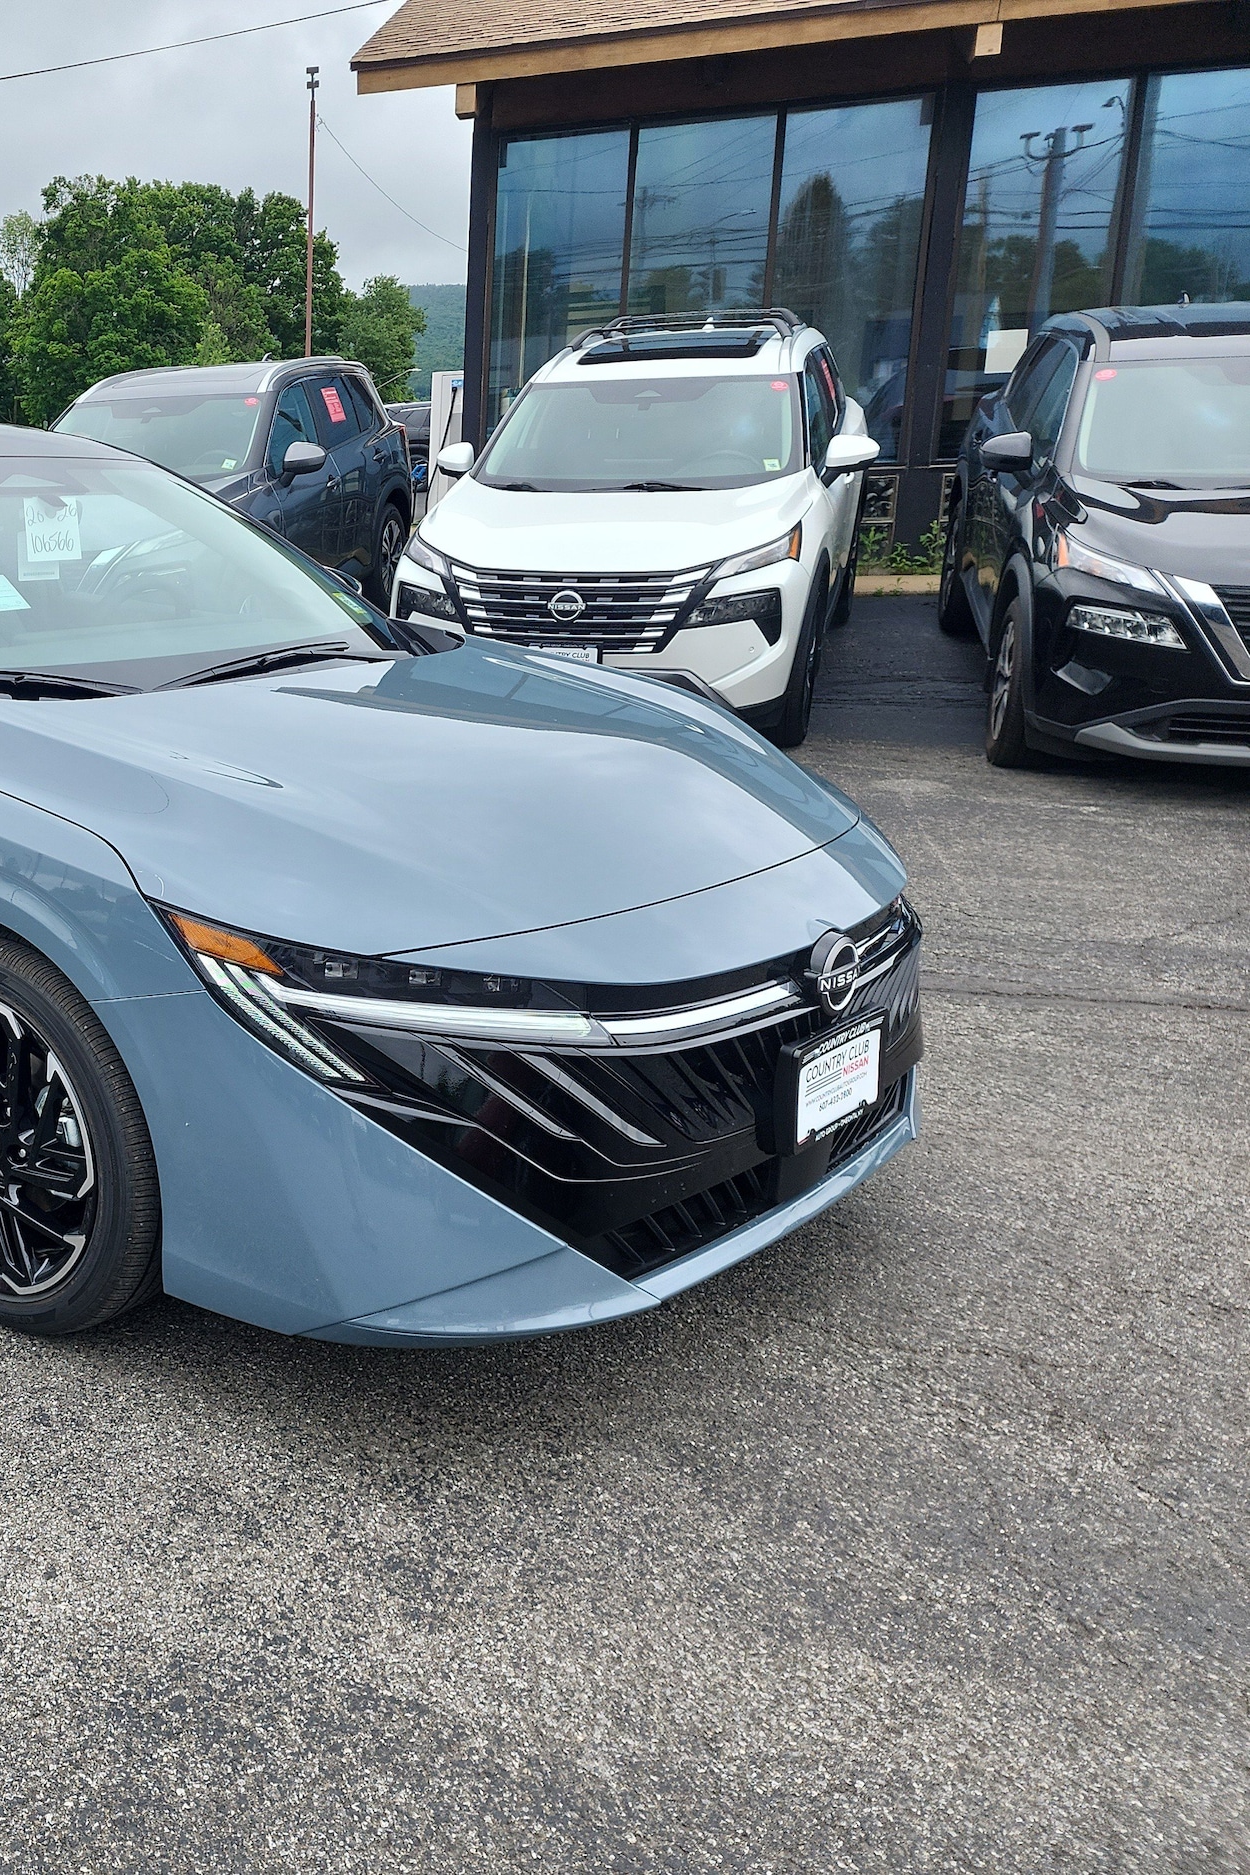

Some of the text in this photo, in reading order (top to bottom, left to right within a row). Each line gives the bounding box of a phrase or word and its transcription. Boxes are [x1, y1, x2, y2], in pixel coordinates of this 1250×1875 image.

[26, 503, 77, 526] 20 26
[30, 530, 75, 554] 106566
[818, 1022, 867, 1055] COUNTRY CLUB
[806, 1039, 870, 1083] COUNTRY CLUB
[842, 1055, 869, 1077] NISSAN
